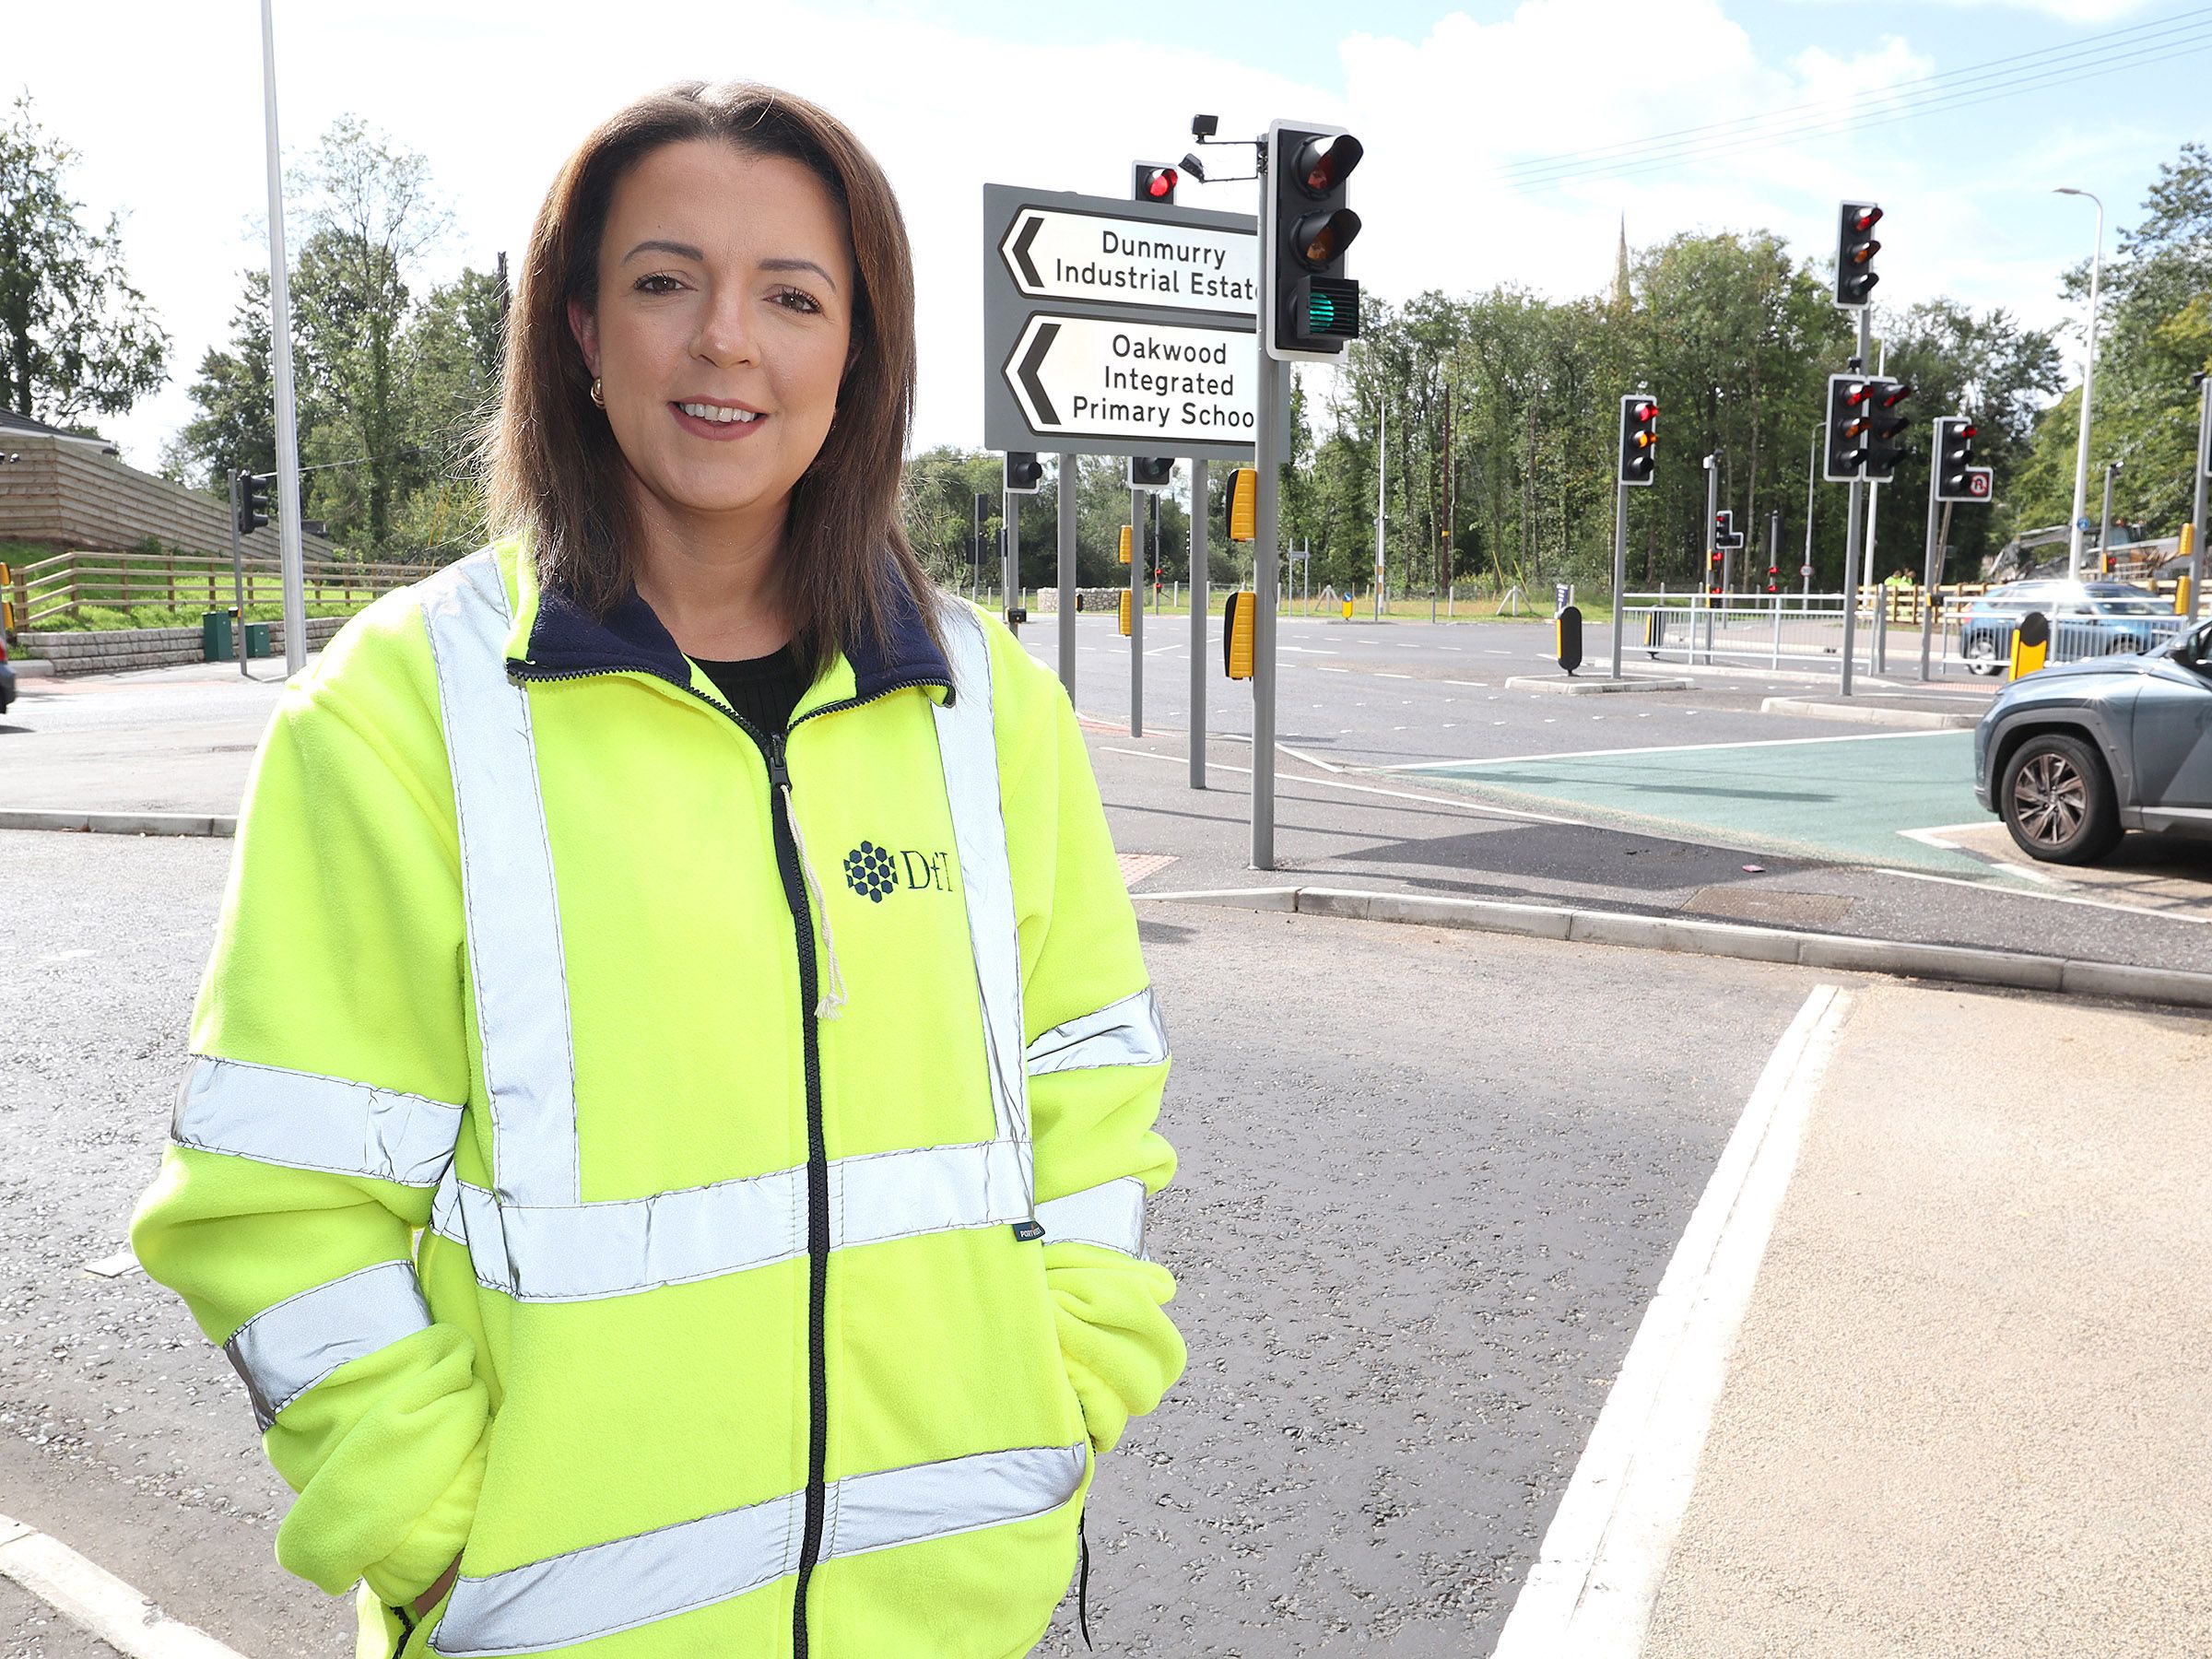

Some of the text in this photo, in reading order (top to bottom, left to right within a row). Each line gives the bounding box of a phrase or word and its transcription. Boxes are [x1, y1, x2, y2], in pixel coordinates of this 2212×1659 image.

[1102, 230, 1227, 270] Dunmurry
[1056, 258, 1258, 300] Industrial Estat
[1112, 334, 1227, 365] Oakwood
[1105, 365, 1234, 396] Integrated
[1073, 395, 1254, 428] Primary Schoo
